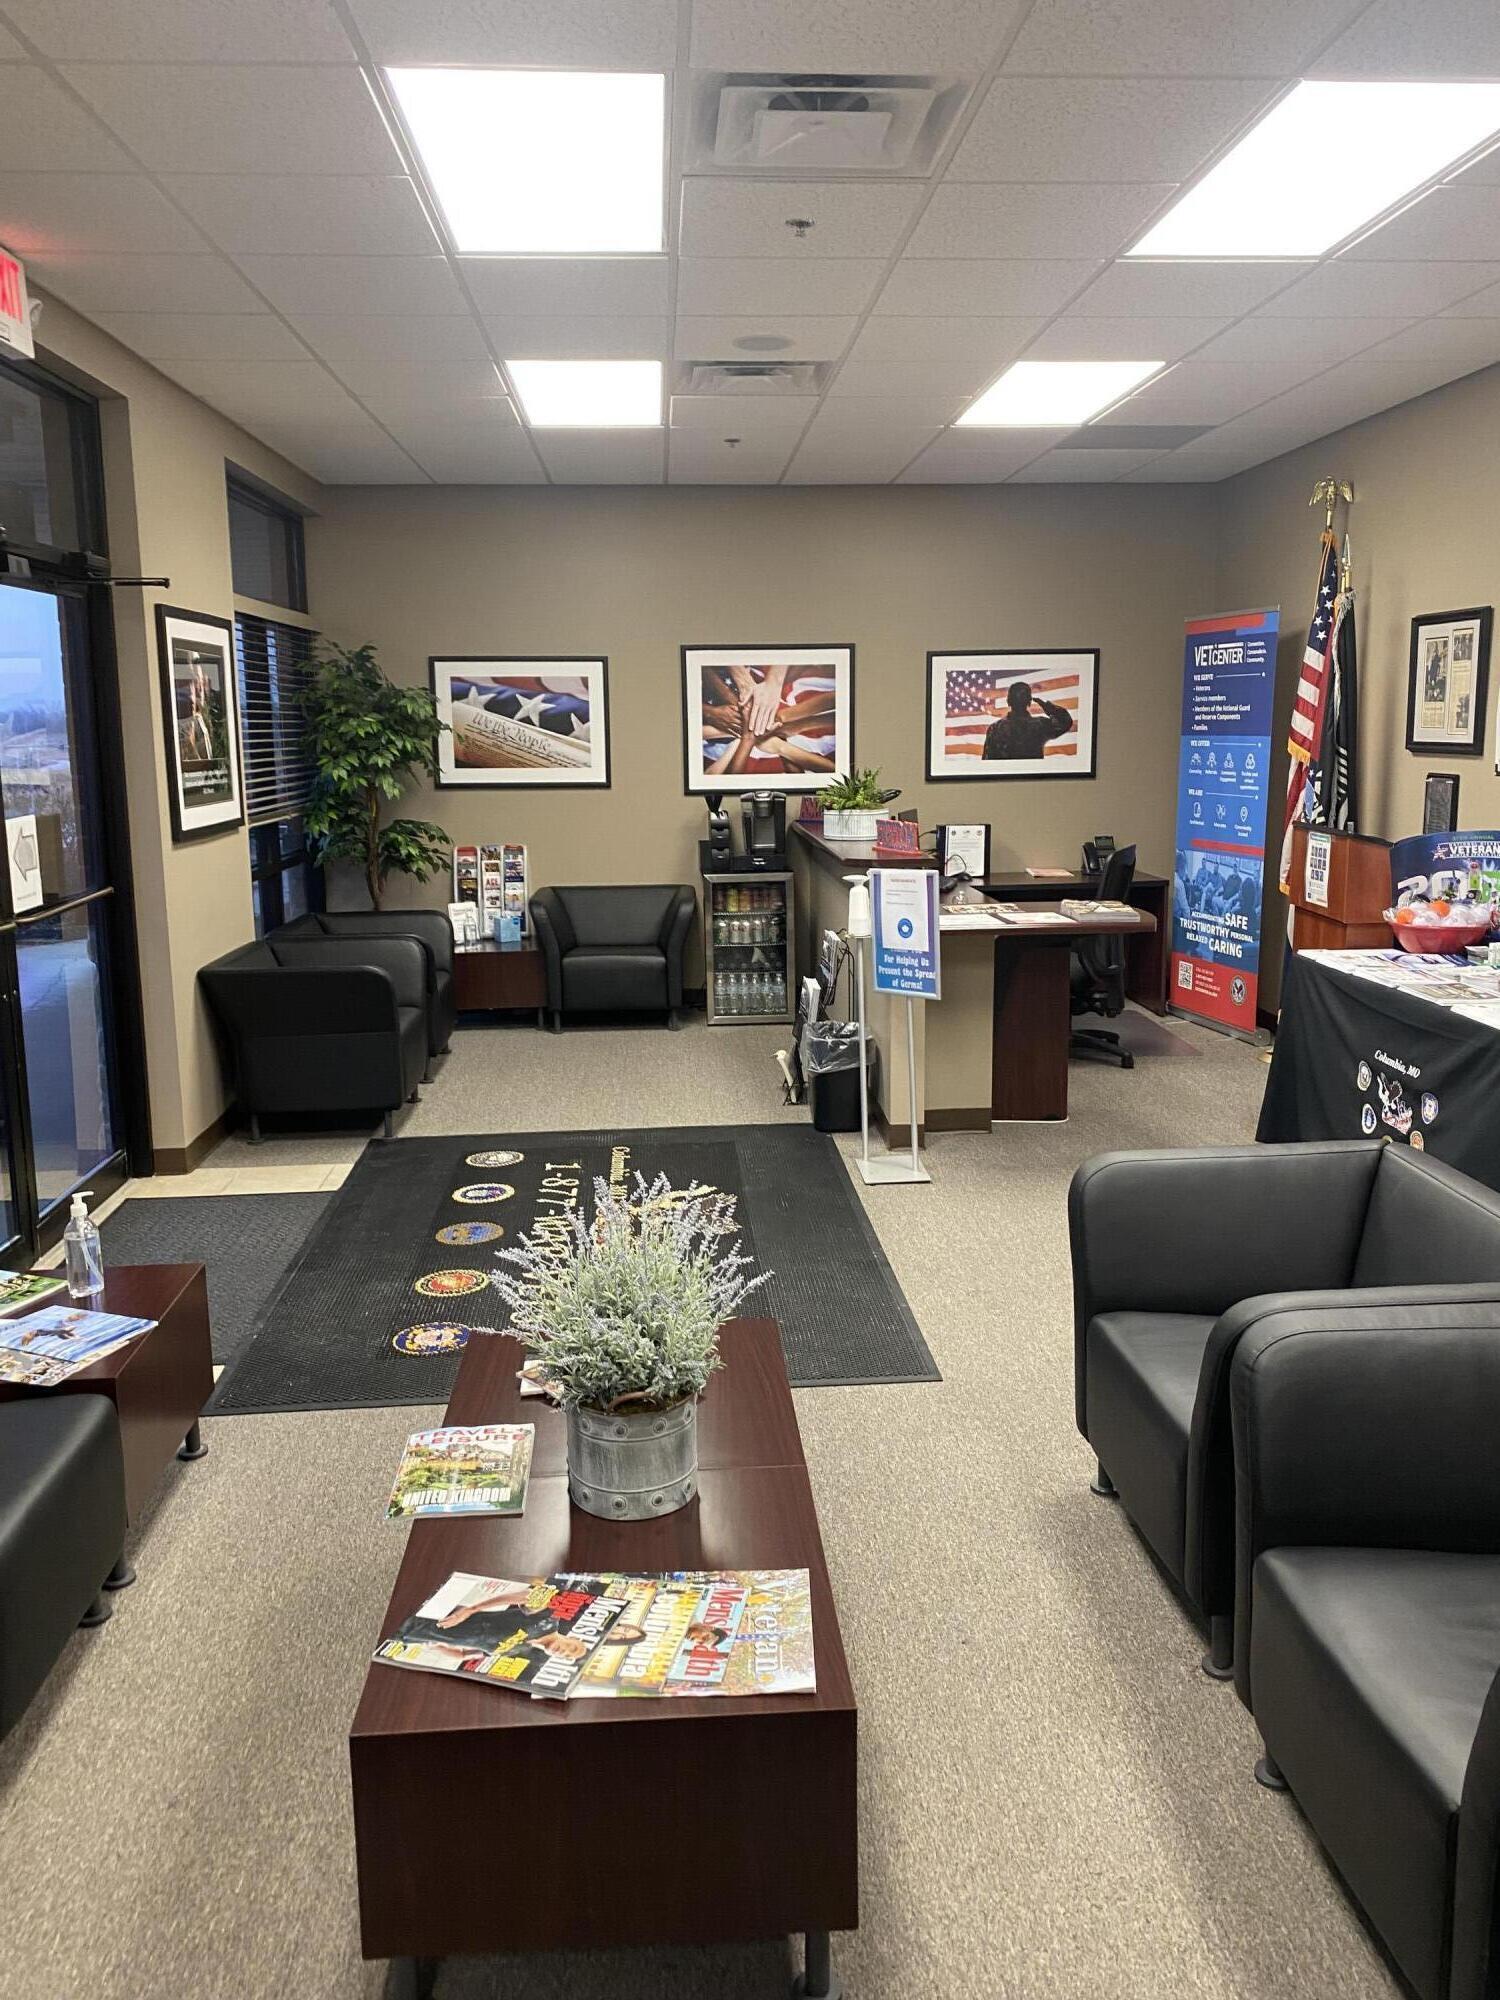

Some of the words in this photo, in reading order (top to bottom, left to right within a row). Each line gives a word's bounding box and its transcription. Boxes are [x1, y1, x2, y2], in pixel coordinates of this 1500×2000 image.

[1195, 645, 1214, 667] VET
[1213, 648, 1243, 666] CENTER
[1179, 917, 1230, 939] TRUSTWORTHY
[1230, 931, 1254, 943] PERSONAL
[1225, 912, 1249, 931] SAFE
[1186, 932, 1208, 945] RELAXED
[1208, 938, 1243, 959] CARING
[896, 955, 919, 967] Helping
[892, 978, 899, 987] of
[902, 967, 913, 977] the
[1374, 1049, 1407, 1075] Columbia,
[1407, 1064, 1421, 1079] MO
[402, 1489, 448, 1508] UNITED
[448, 1487, 512, 1504] KINGDOM
